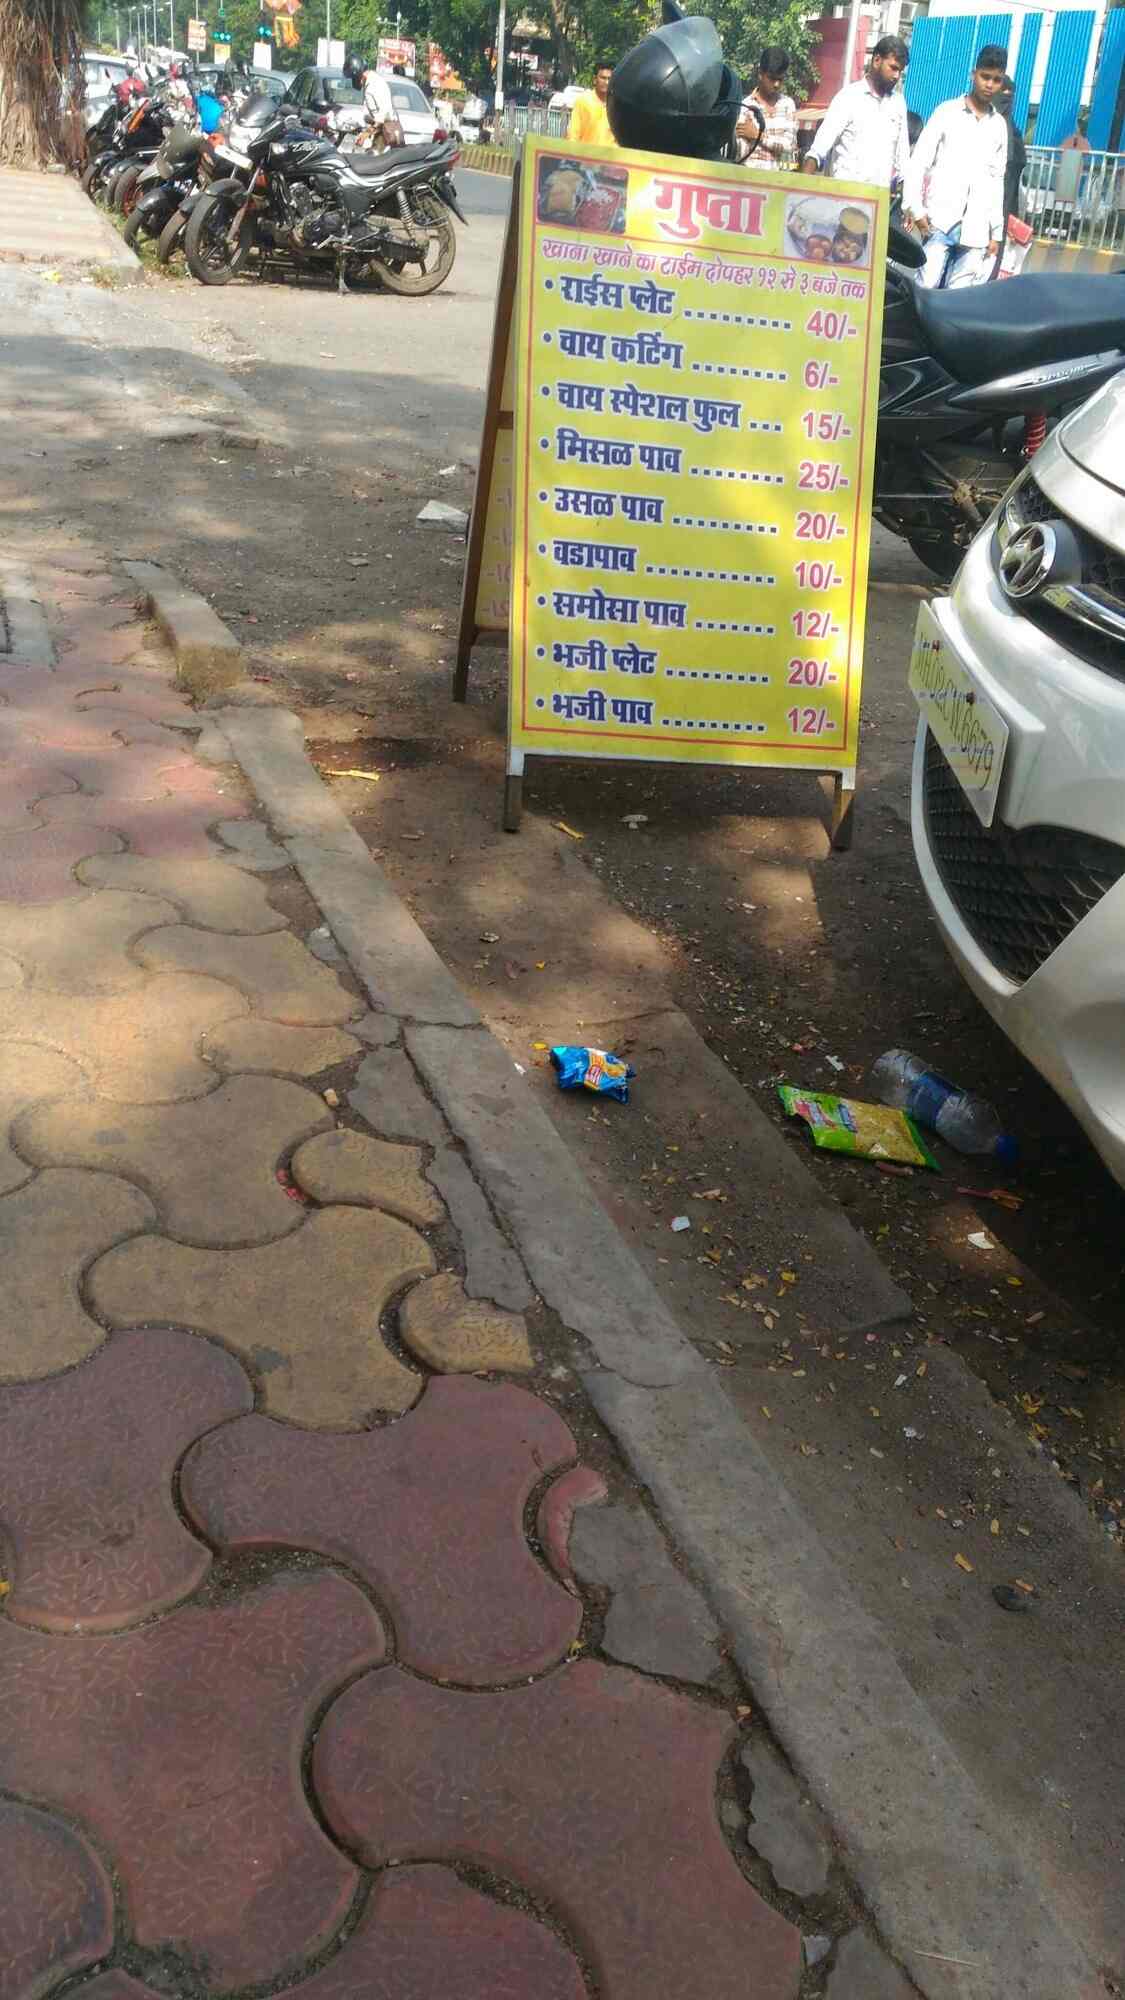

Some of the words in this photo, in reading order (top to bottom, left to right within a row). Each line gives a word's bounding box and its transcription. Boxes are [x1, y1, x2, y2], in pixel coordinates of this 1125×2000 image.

[653, 179, 767, 239] गुप्ता
[542, 239, 588, 262] खाना
[593, 243, 633, 268] खाने
[636, 253, 656, 271] का
[660, 253, 702, 280] टाईम
[705, 256, 753, 285] दोपहर
[781, 265, 797, 290] से
[800, 273, 809, 295] ३
[812, 271, 838, 295] बजे
[841, 279, 866, 299] तक
[560, 274, 625, 309] राईस
[628, 280, 675, 314] प्लेट
[807, 310, 857, 340] 40/-
[558, 330, 606, 360] चाय
[611, 332, 684, 368] कटिंग
[804, 361, 838, 388] 6/-
[557, 383, 605, 412] चाय
[610, 384, 689, 421] स्पेशल
[693, 399, 742, 431] फुल
[802, 412, 851, 440] 15/-
[556, 428, 635, 466] मिसळ
[639, 445, 682, 473] पाव
[799, 462, 849, 491] 25/-
[555, 488, 616, 516] उसळ
[620, 496, 664, 523] पाव
[796, 512, 845, 540] 20/-
[553, 540, 637, 572] वडापाव
[795, 561, 842, 590] 10/-
[552, 588, 640, 624] समोसा
[643, 601, 686, 628] पाव
[792, 611, 839, 638] 12/-
[553, 640, 607, 671] भजी
[612, 643, 657, 674] प्लेट
[788, 660, 837, 686] 20/-
[553, 690, 607, 721] भजी
[610, 699, 653, 725] पाव
[787, 708, 834, 735] 12/-
